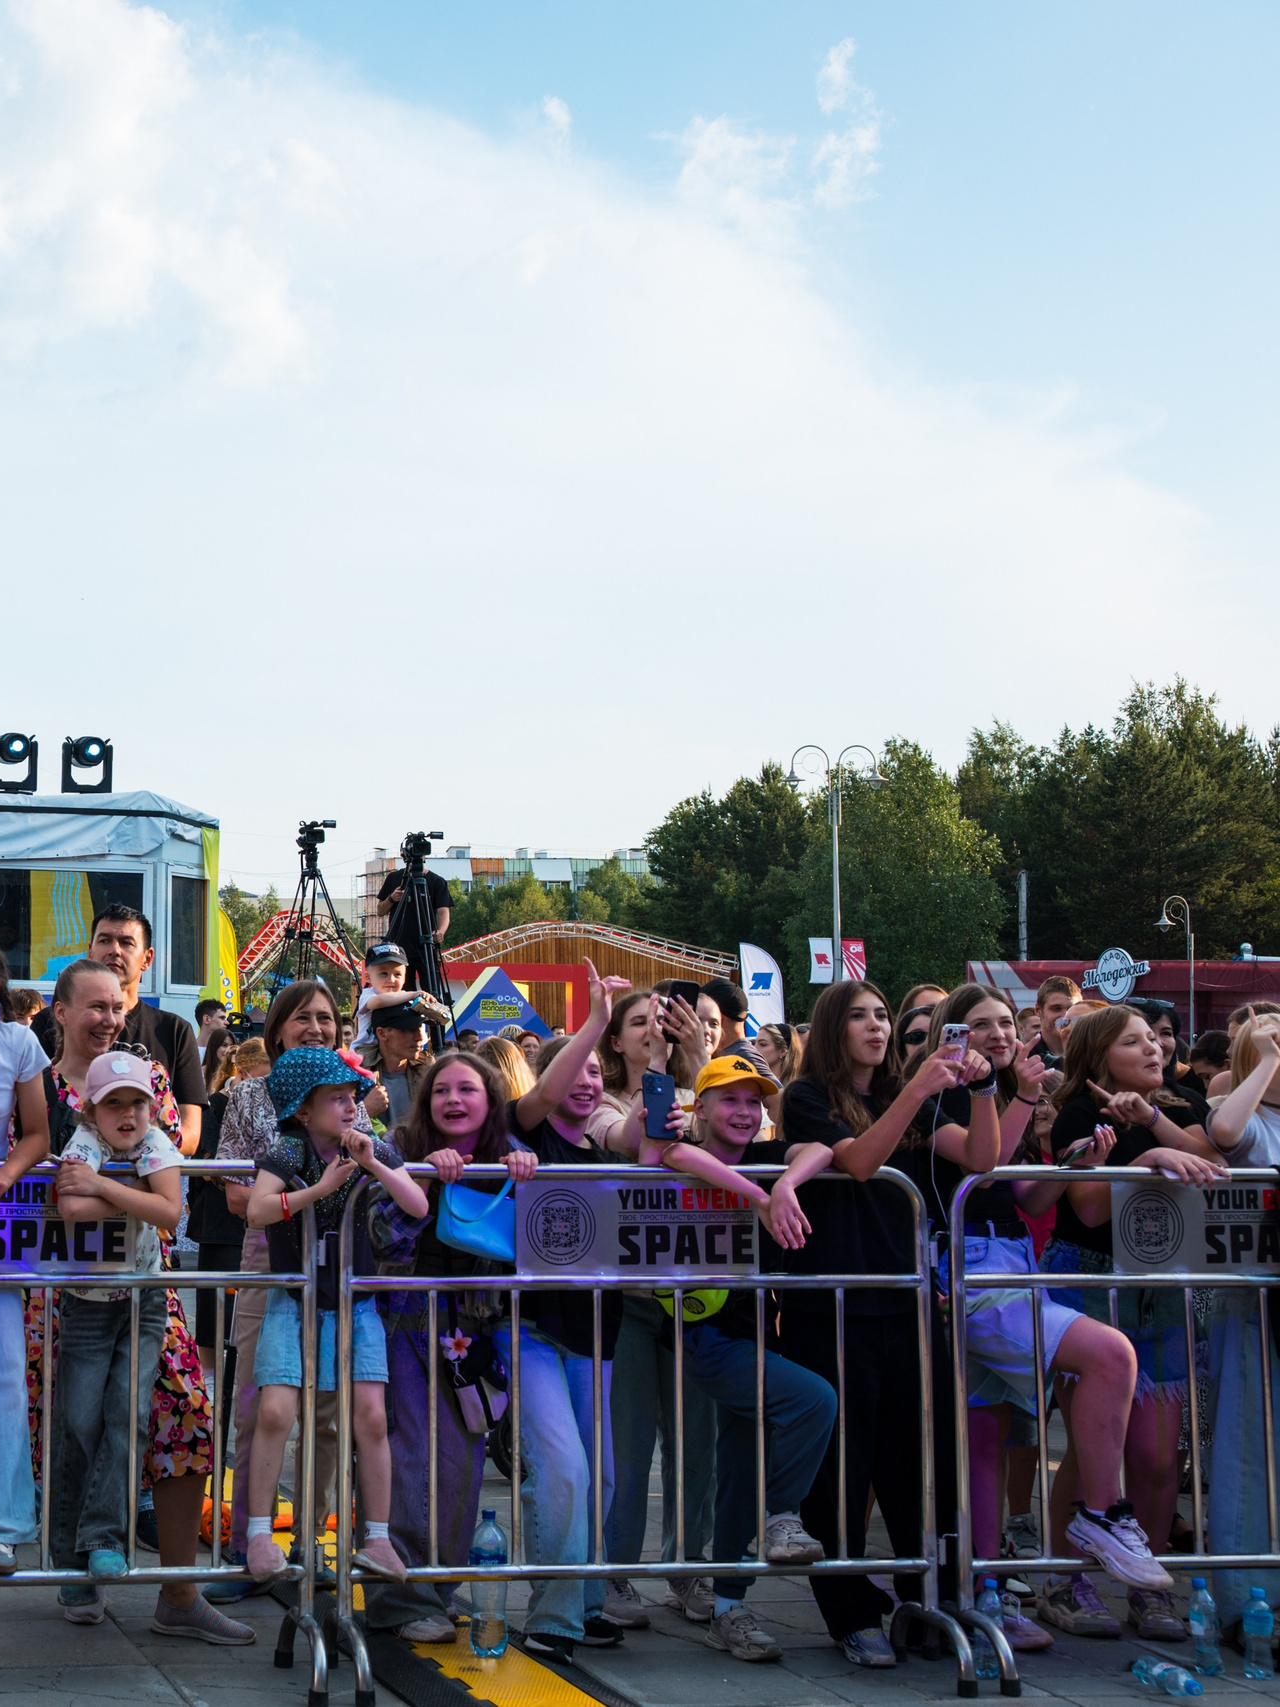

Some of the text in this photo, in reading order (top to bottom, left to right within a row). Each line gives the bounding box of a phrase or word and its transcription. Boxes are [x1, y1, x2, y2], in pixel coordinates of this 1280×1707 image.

[1102, 952, 1126, 965] КАФЕ
[1082, 962, 1146, 987] Молодежка
[617, 1188, 678, 1210] YOUR
[1202, 1189, 1259, 1210] YOUR
[698, 1213, 754, 1221] МЕРОПРИЯТИЙ
[618, 1225, 755, 1265] SPACE
